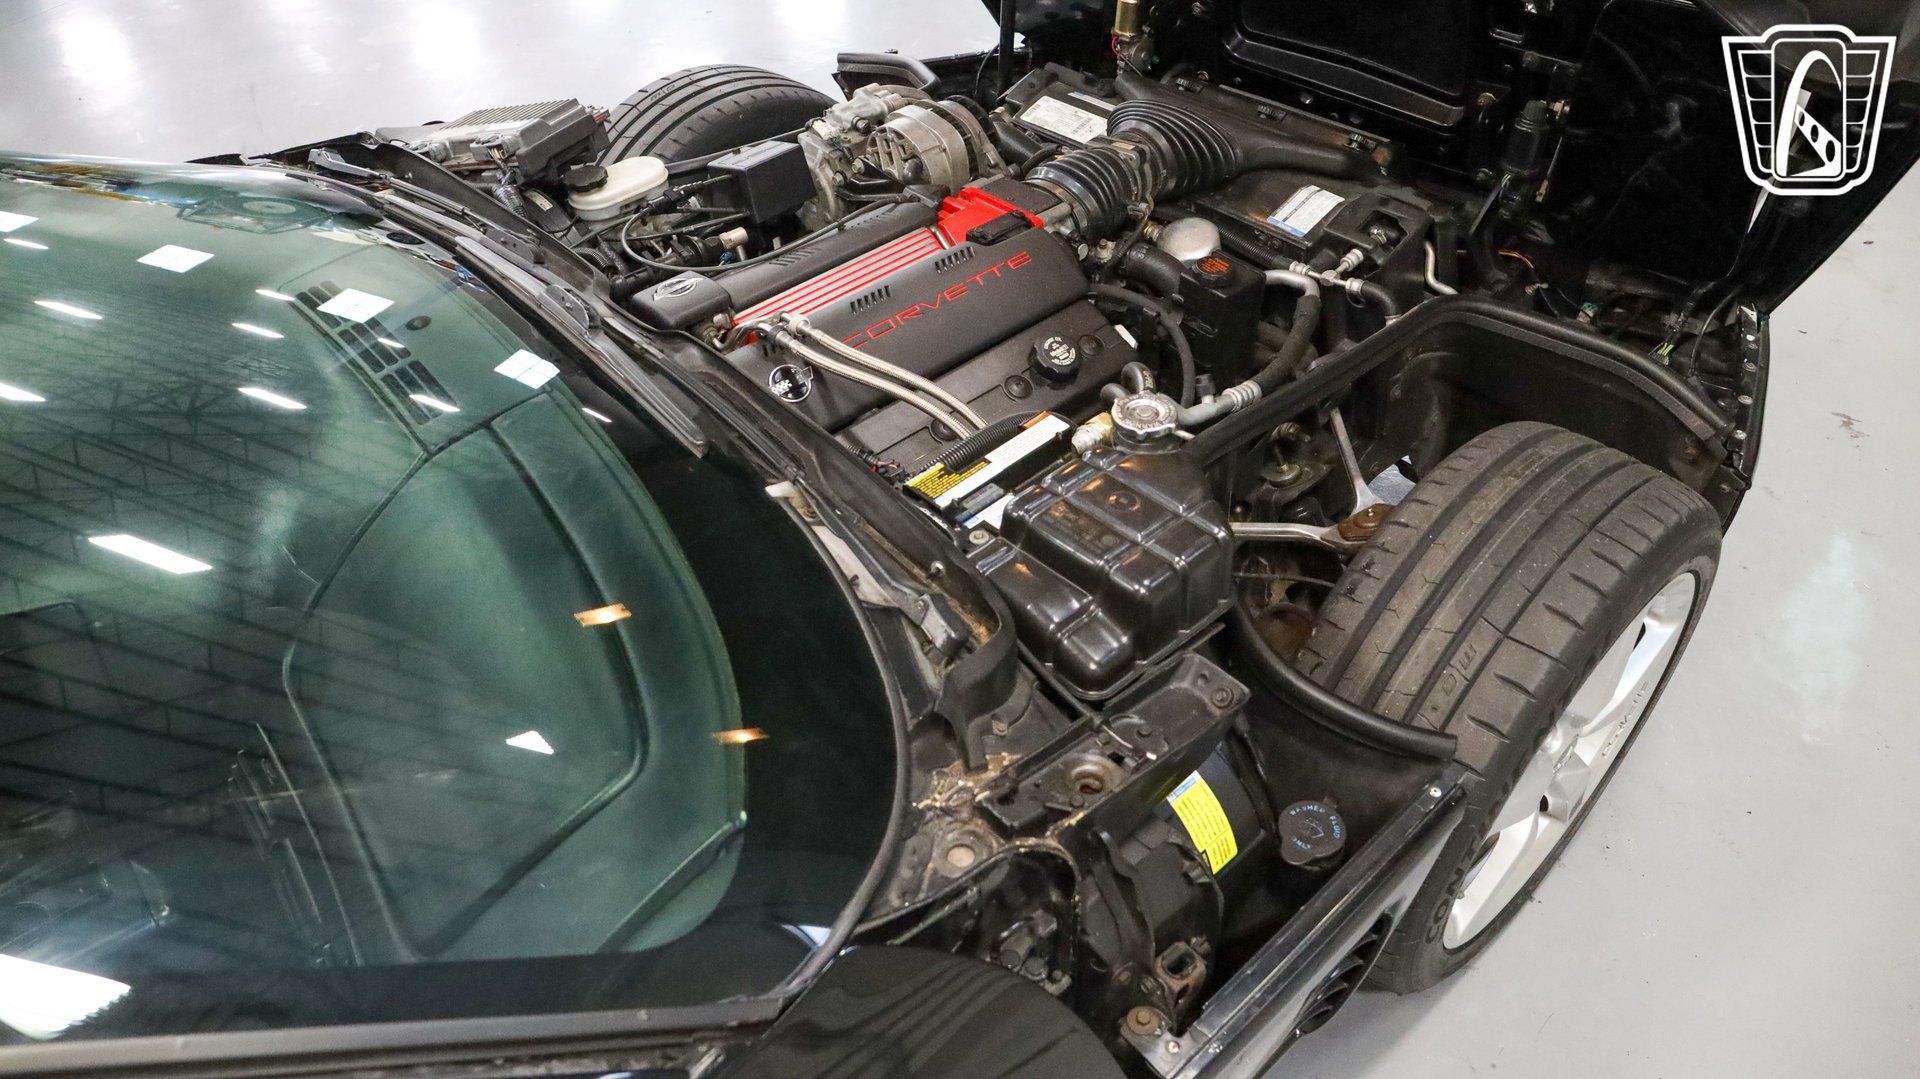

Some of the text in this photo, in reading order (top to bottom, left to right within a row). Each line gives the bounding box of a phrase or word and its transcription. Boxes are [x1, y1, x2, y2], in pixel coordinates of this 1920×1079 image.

[840, 251, 1033, 350] CORVETTE
[1289, 804, 1341, 850] WASHER FLUID ONLY
